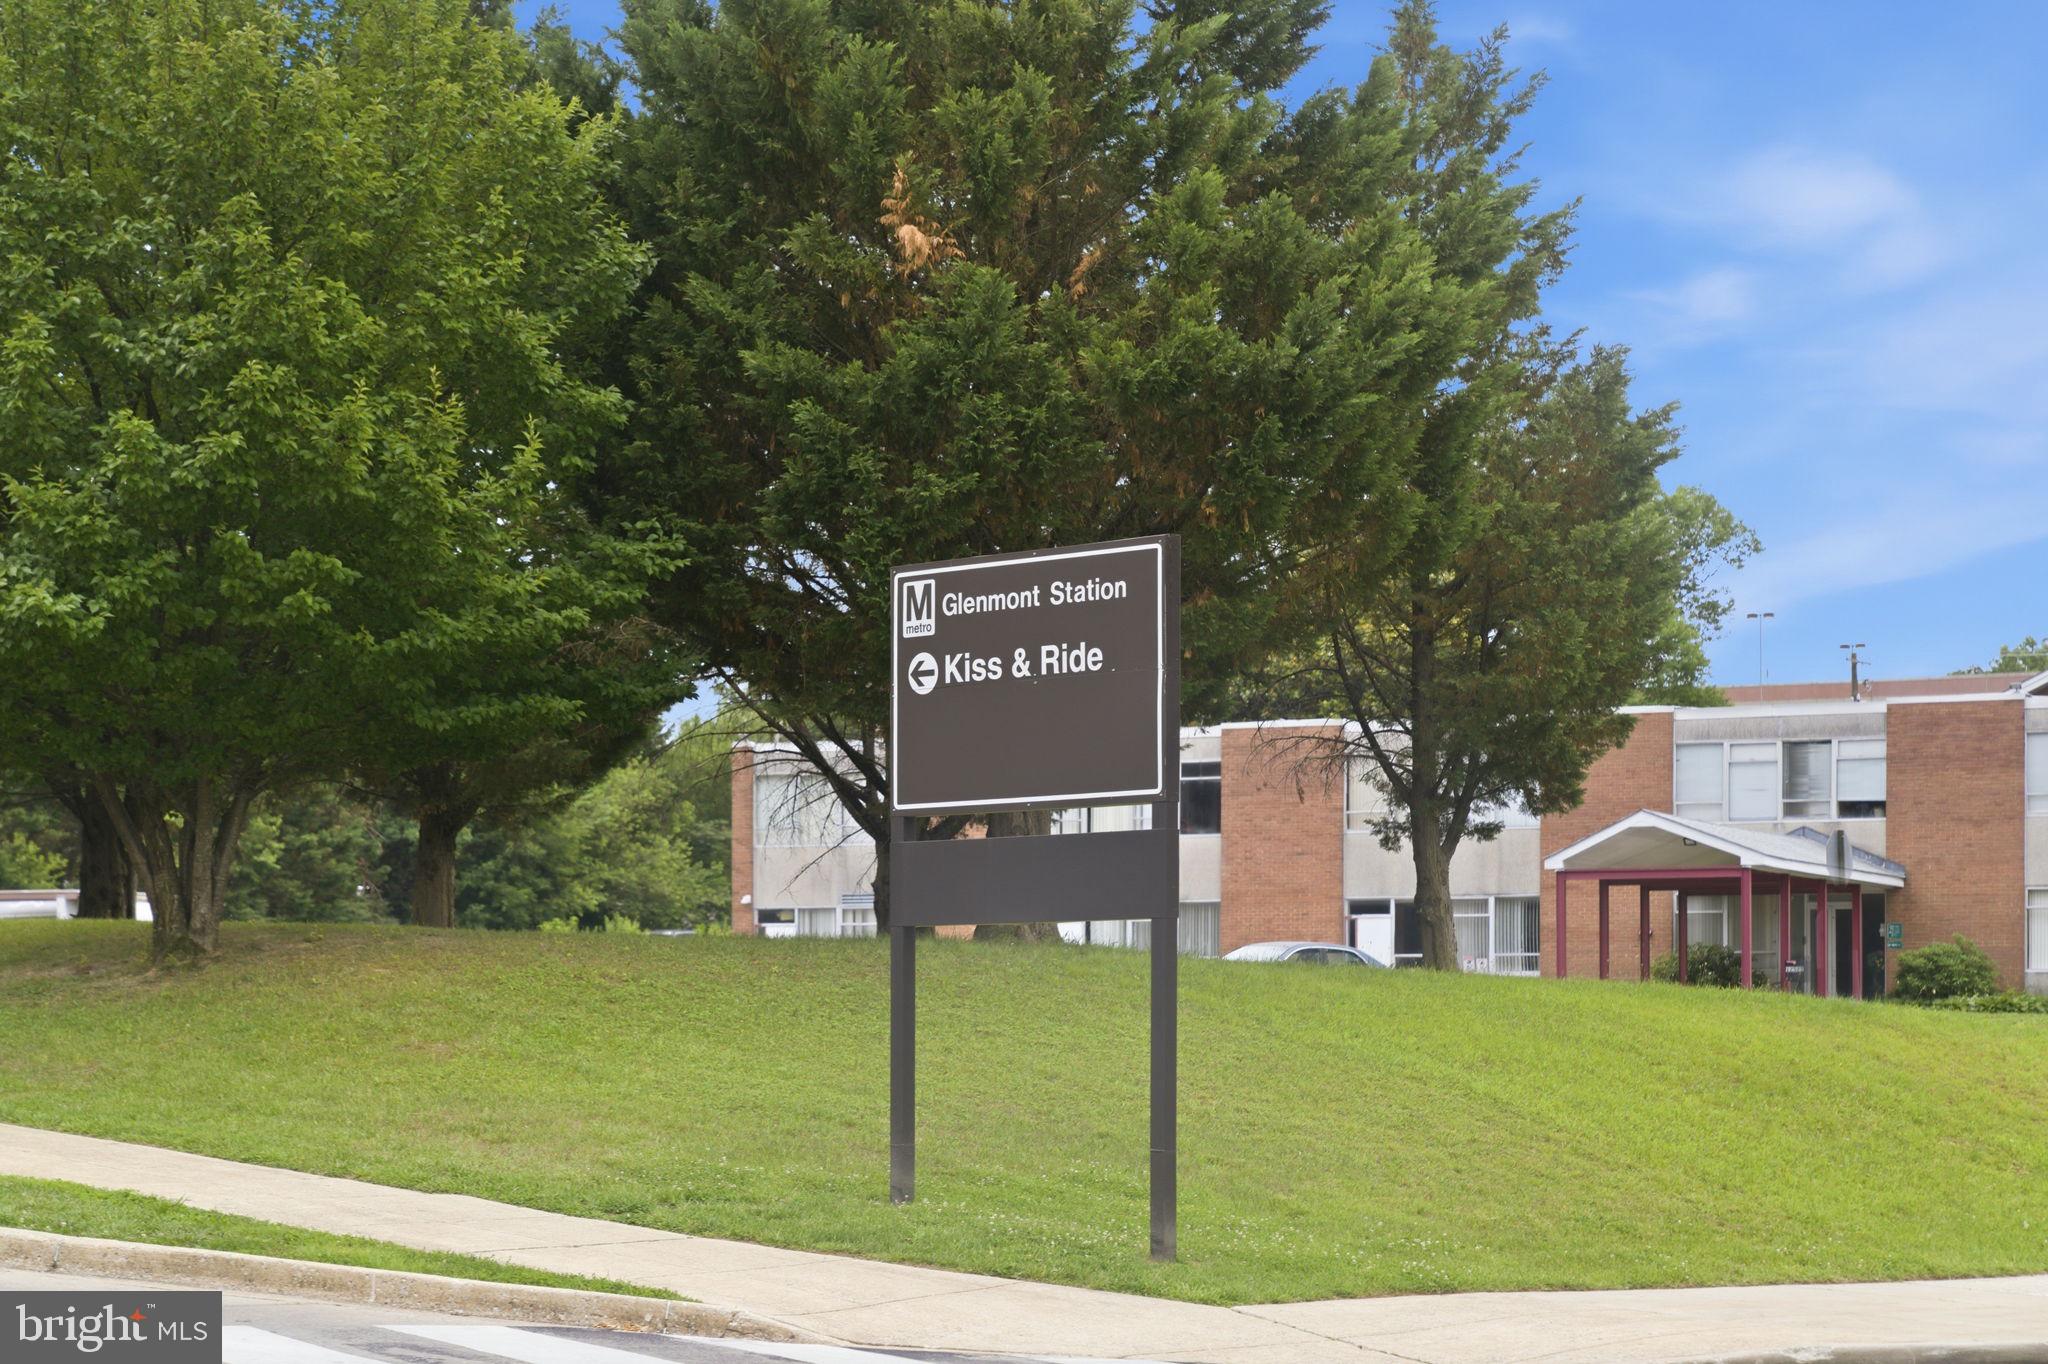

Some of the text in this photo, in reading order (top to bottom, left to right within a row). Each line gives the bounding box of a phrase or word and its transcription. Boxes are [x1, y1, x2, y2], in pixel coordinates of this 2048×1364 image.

[942, 577, 1127, 617] Glenmont Station
[905, 622, 932, 635] metro
[944, 642, 1104, 684] Kiss & Ride
